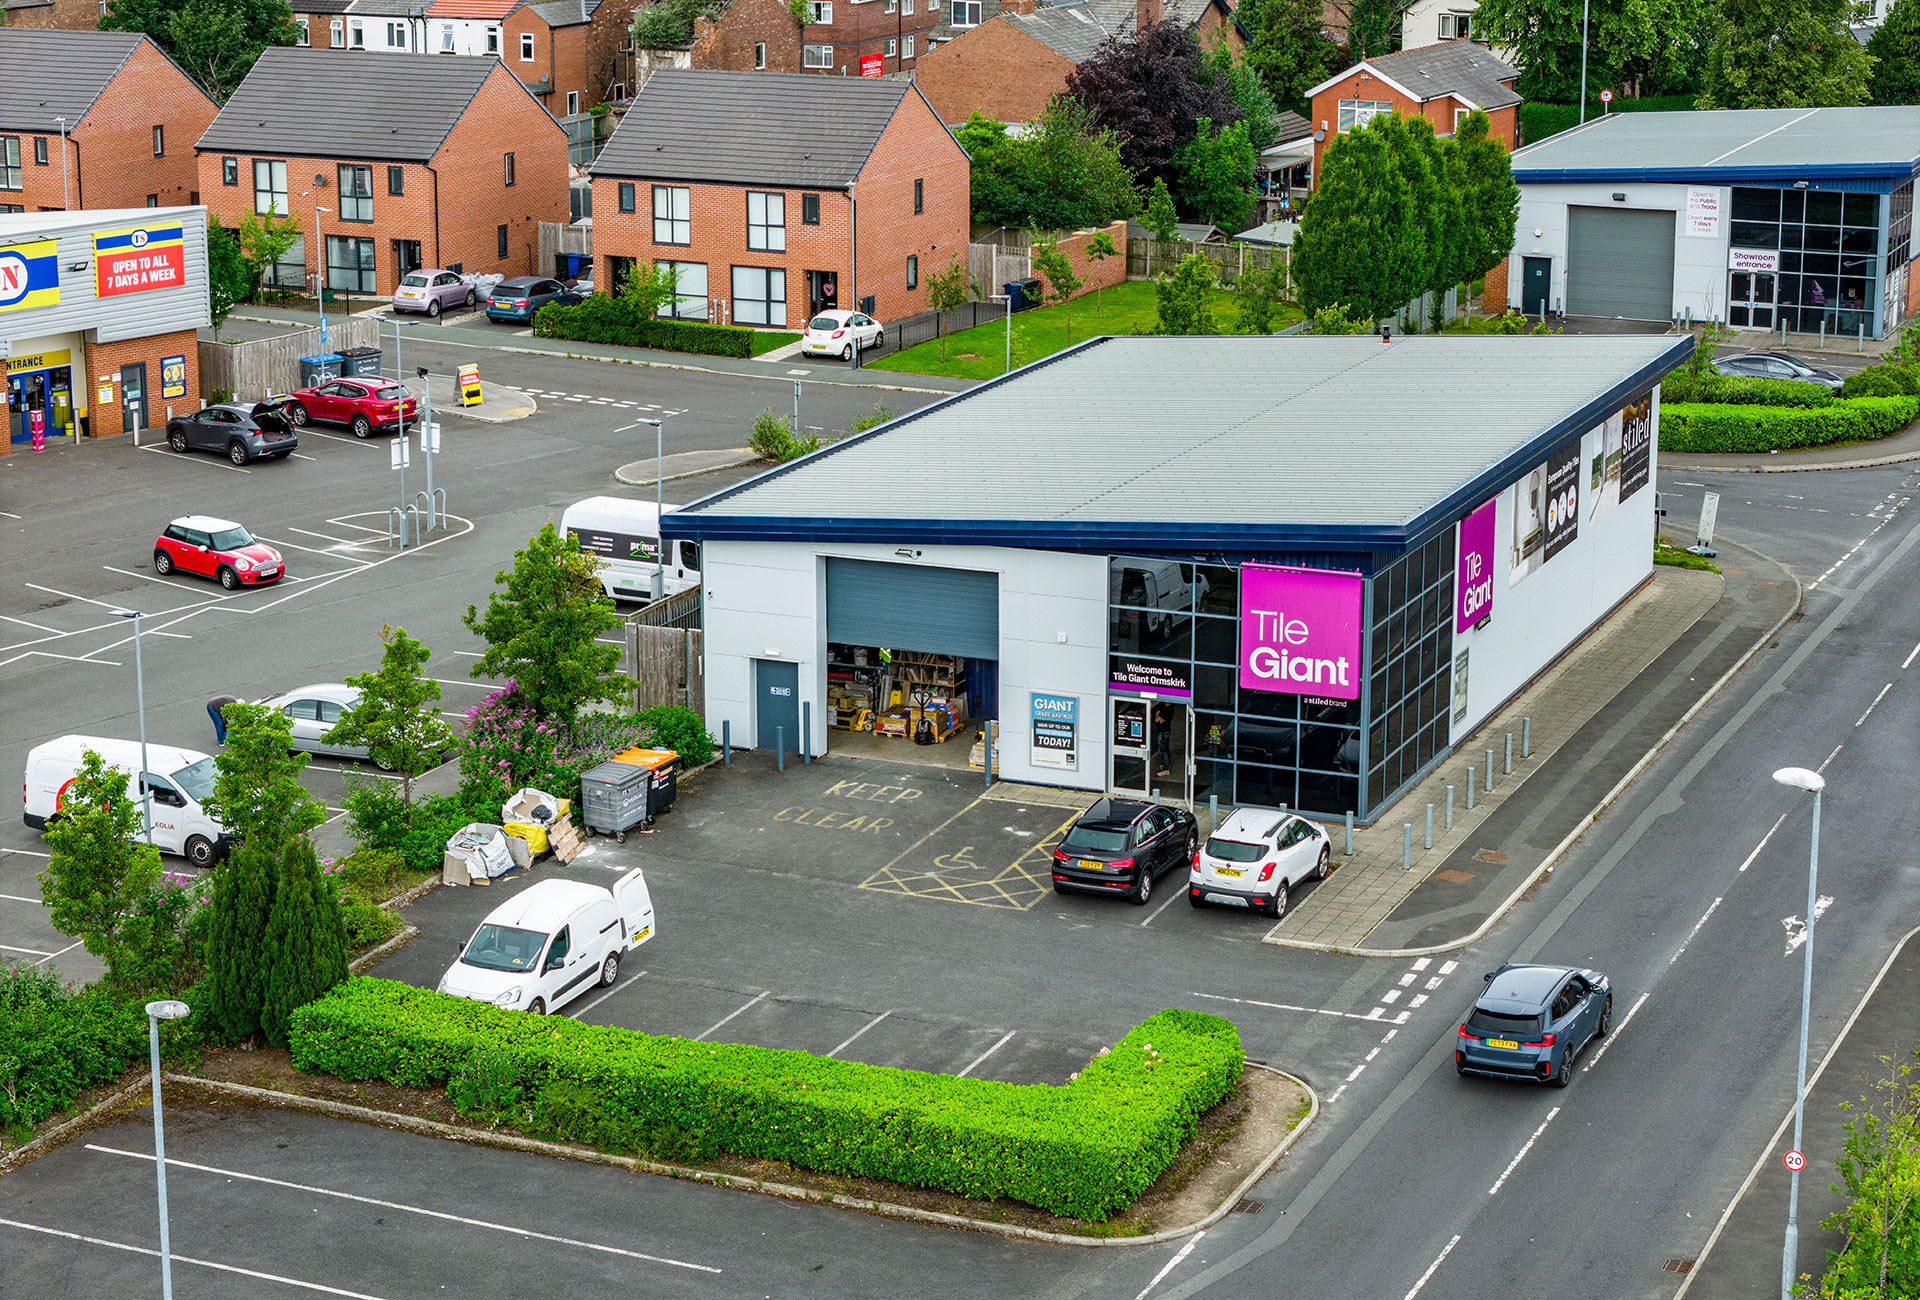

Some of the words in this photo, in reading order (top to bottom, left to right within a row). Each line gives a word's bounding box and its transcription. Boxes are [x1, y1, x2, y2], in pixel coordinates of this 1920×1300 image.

[134, 234, 146, 244] TS
[1733, 252, 1776, 261] Showroom
[112, 259, 138, 274] OPEN
[139, 257, 150, 270] TO
[152, 255, 169, 268] ALL
[1736, 261, 1773, 269] entrance
[106, 276, 113, 289] 7
[115, 273, 139, 288] DAYS
[140, 271, 148, 284] A
[149, 268, 176, 283] WEEK
[6, 356, 43, 371] NTRANCE
[1622, 408, 1650, 455] stiled
[630, 541, 655, 552] prima
[1465, 551, 1482, 584] Tile
[1463, 574, 1491, 618] Giant
[1250, 609, 1309, 645] Tile
[1126, 663, 1162, 675] Welcome
[1163, 667, 1172, 676] to
[1249, 646, 1349, 686] Giant
[1113, 671, 1127, 682] Tile
[1128, 673, 1149, 684] Giant
[1150, 676, 1186, 688] Ormskirk
[1034, 698, 1074, 712] GIANT
[1308, 697, 1329, 706] stiled
[1329, 699, 1347, 708] brand
[1052, 712, 1074, 720] SAVINGS
[1037, 736, 1071, 748] TODAY!
[823, 779, 923, 804] KEEP
[155, 821, 175, 830] EOLIA
[773, 806, 895, 835] CLEAR
[1787, 1155, 1802, 1166] 20
